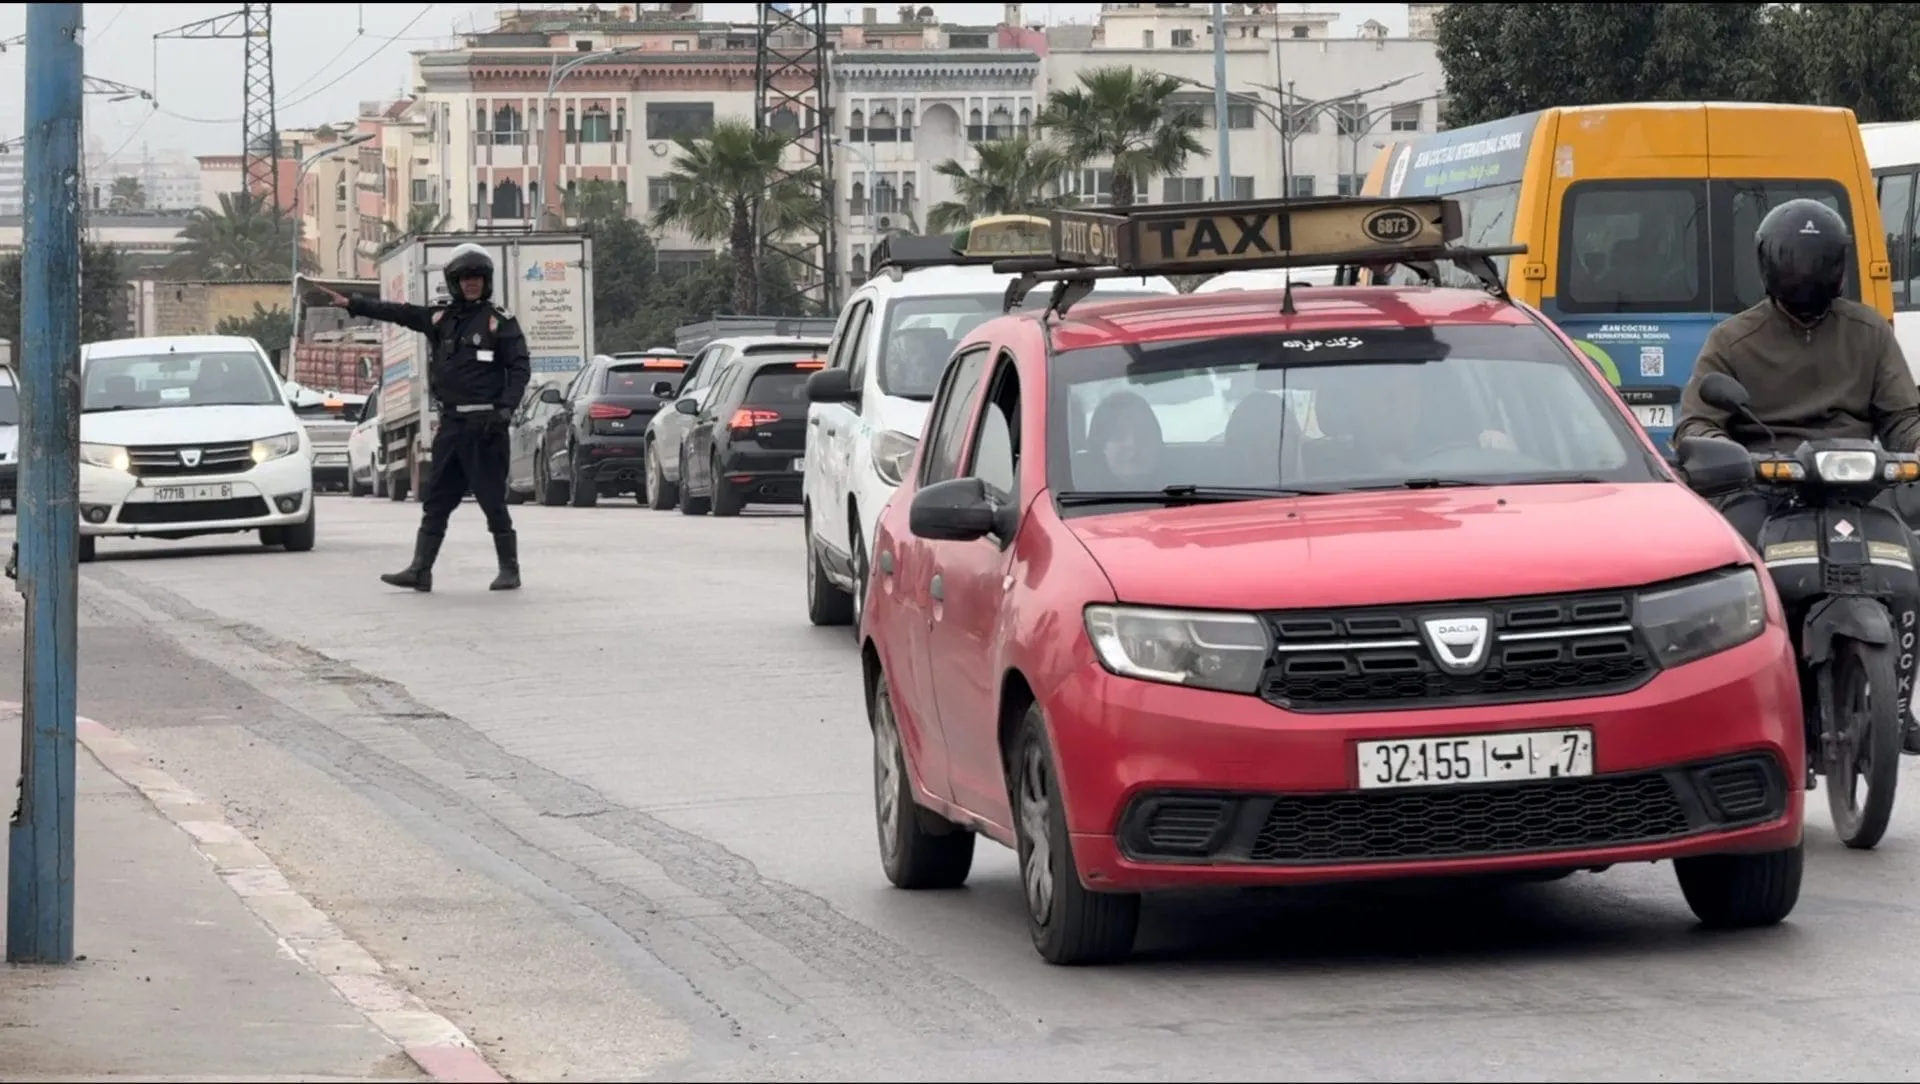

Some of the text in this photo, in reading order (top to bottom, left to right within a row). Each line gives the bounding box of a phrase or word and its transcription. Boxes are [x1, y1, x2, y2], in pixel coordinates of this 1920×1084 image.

[1377, 216, 1410, 234] 6873
[1147, 213, 1292, 260] TAXI
[1586, 332, 1671, 340] INTERNATIONAL SCHOOL
[1649, 407, 1666, 424] 72
[1438, 624, 1479, 634] DACIA
[1376, 734, 1579, 783] 32155 ب 7
